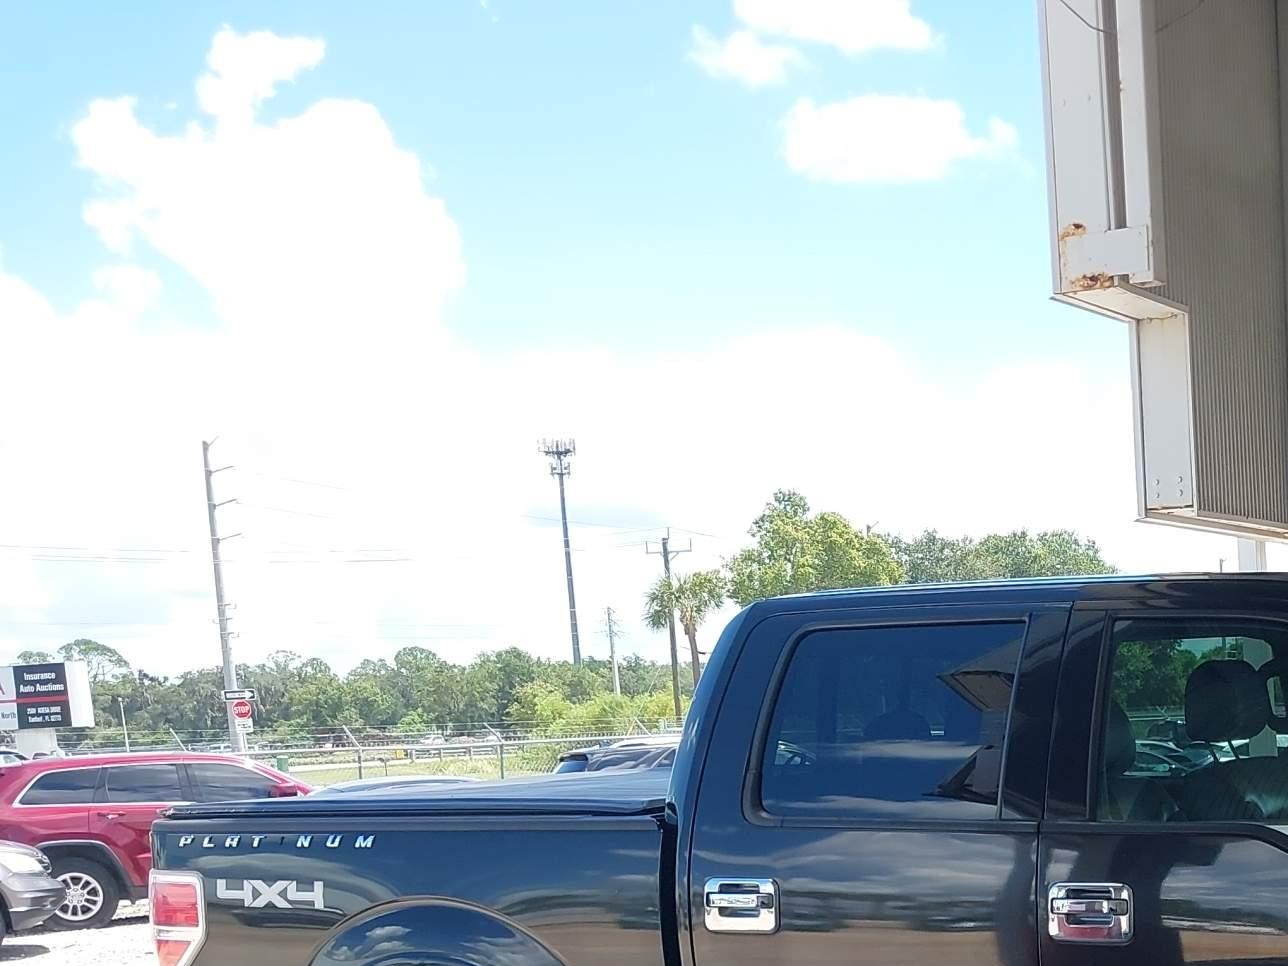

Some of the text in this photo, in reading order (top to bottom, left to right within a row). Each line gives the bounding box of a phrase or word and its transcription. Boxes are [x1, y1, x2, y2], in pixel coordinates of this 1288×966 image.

[23, 672, 56, 681] Insurance
[20, 682, 65, 693] Auto Auctions
[233, 705, 251, 714] STOP
[178, 834, 376, 849] PLATNUM
